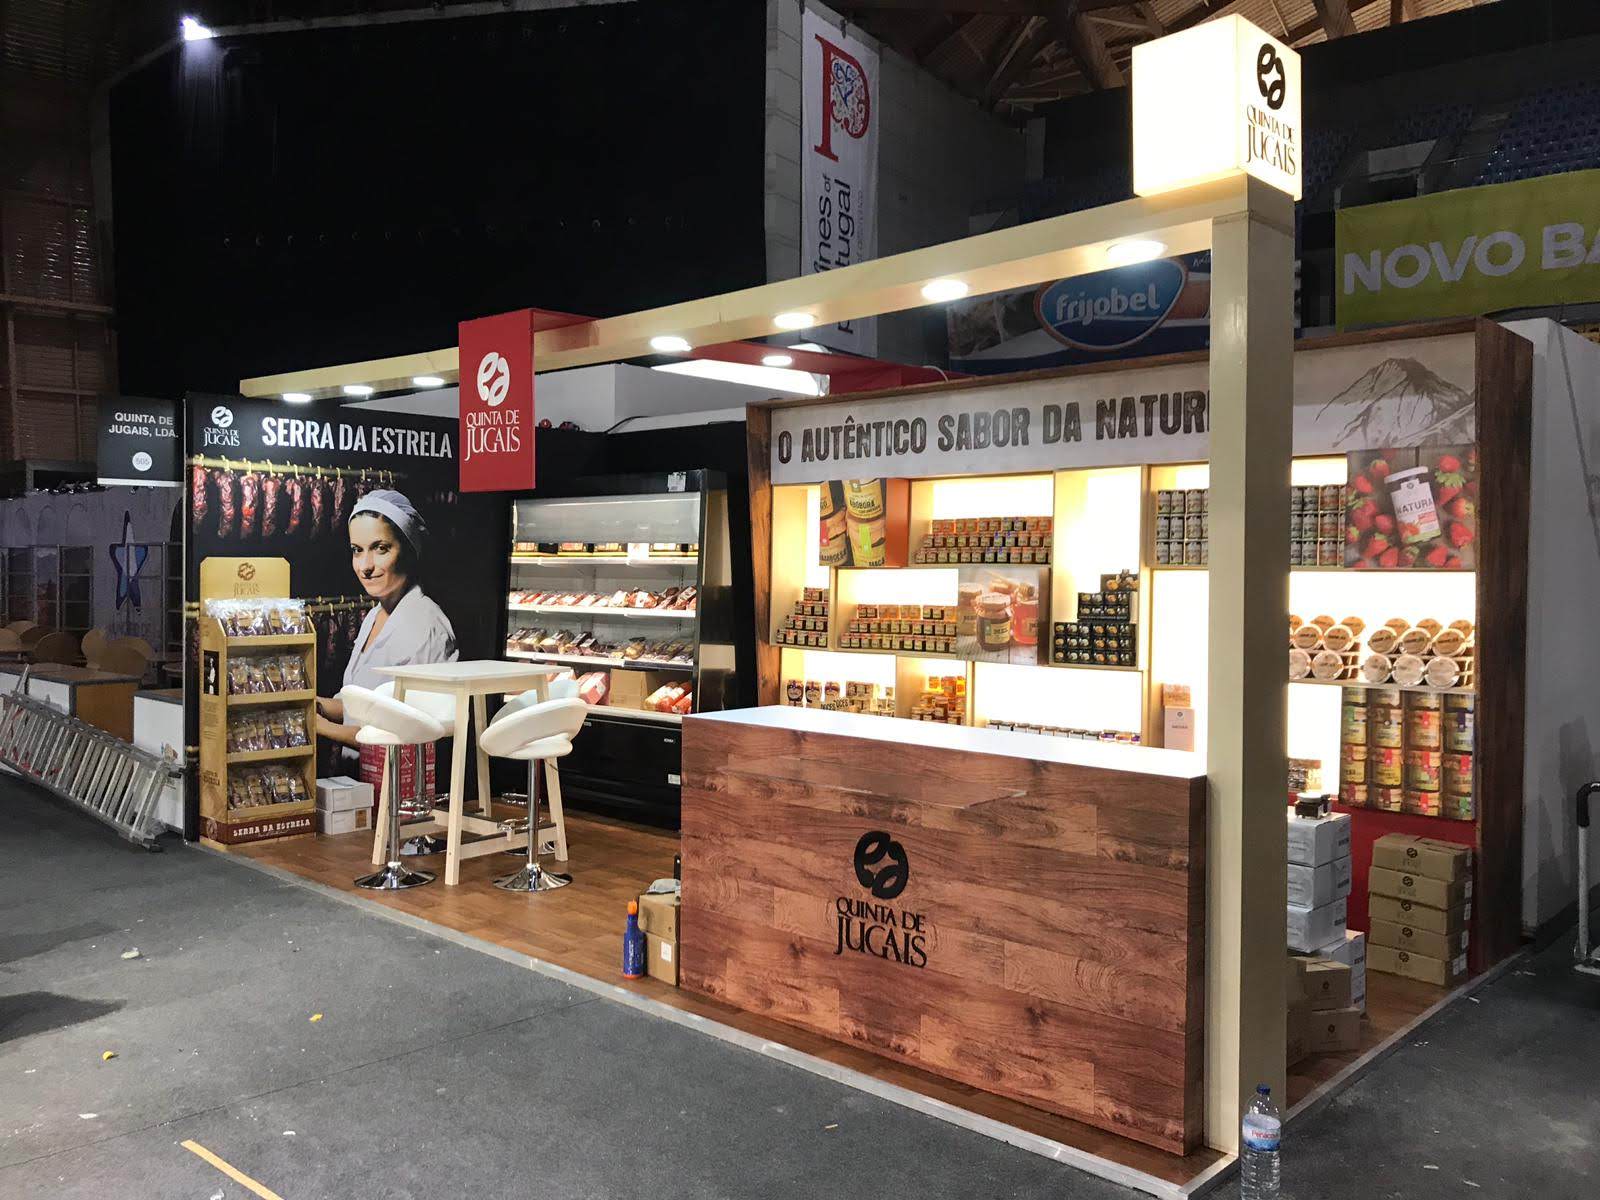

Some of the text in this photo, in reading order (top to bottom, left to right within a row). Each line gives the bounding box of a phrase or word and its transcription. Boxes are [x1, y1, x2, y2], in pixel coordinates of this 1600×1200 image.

[1247, 105, 1295, 144] QUINTA DE
[1246, 124, 1296, 176] JUGAIS
[813, 173, 831, 273] ines of
[1343, 231, 1526, 295] NOVO
[1056, 283, 1161, 326] frijobel
[108, 425, 179, 438] JUGAIS, LDA.
[114, 412, 173, 425] QUINTA DE
[203, 427, 229, 436] QUINTA
[261, 416, 452, 458] SERRA DA ESTRELA
[466, 409, 520, 428] QUINTA DE
[778, 390, 1210, 464] O AUTÊNTICO SABOR DA NATUR
[203, 433, 240, 447] JUGAIS
[464, 426, 521, 461] JUGAIS
[233, 826, 260, 837] SERRA
[263, 824, 274, 832] DA
[276, 819, 311, 831] ESTRELA
[836, 896, 926, 934] QUINTA DE
[833, 916, 928, 968] JUGAIS
